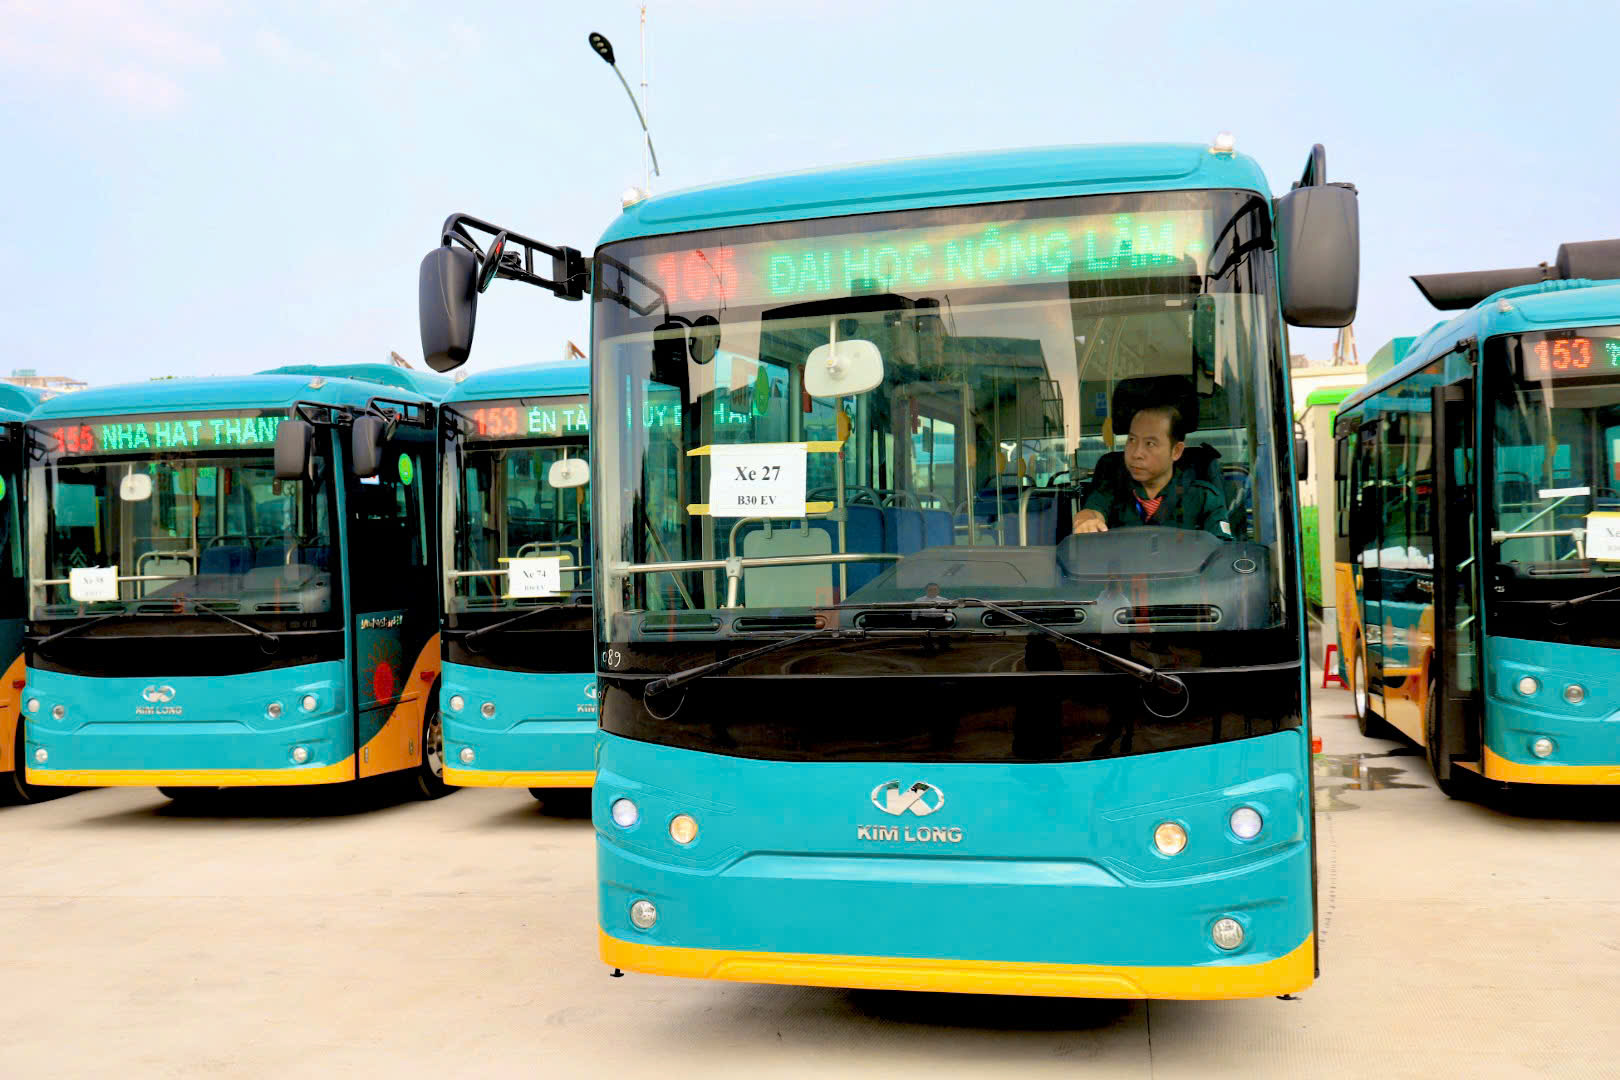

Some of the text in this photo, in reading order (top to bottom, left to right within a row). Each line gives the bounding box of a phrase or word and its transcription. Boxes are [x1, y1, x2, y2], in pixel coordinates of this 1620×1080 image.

[1533, 338, 1592, 371] 153
[474, 405, 518, 436] 153
[735, 465, 781, 481] Xe 27
[737, 495, 777, 505] B30 EV
[857, 823, 964, 843] KIM LONG
